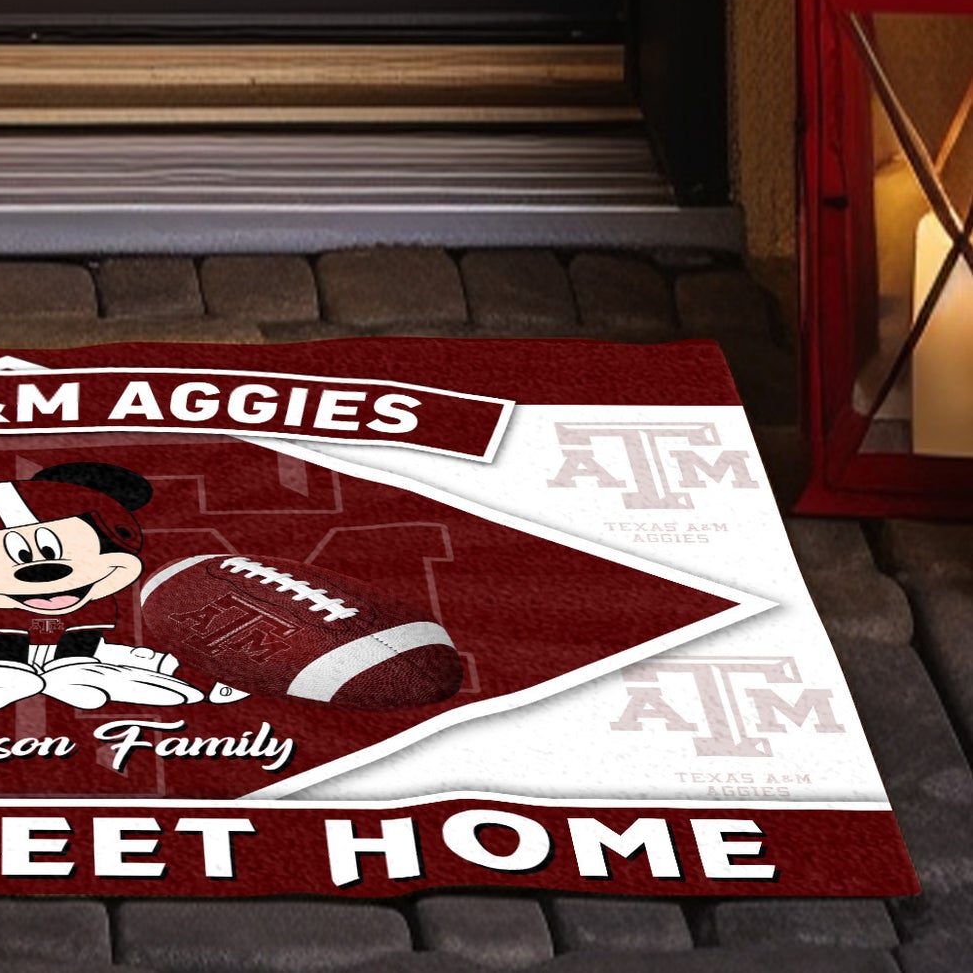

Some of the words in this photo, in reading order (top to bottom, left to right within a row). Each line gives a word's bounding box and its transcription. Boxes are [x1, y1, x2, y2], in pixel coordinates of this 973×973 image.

[108, 380, 423, 435] AGGIES
[603, 522, 677, 532] TEXAS
[686, 522, 729, 532] A&M
[632, 533, 710, 544] AGGIES
[93, 718, 296, 774] Family
[675, 772, 755, 784] TEXAS
[765, 773, 813, 785] A&M
[706, 786, 791, 797] AGGIES
[324, 808, 781, 888] HOME
